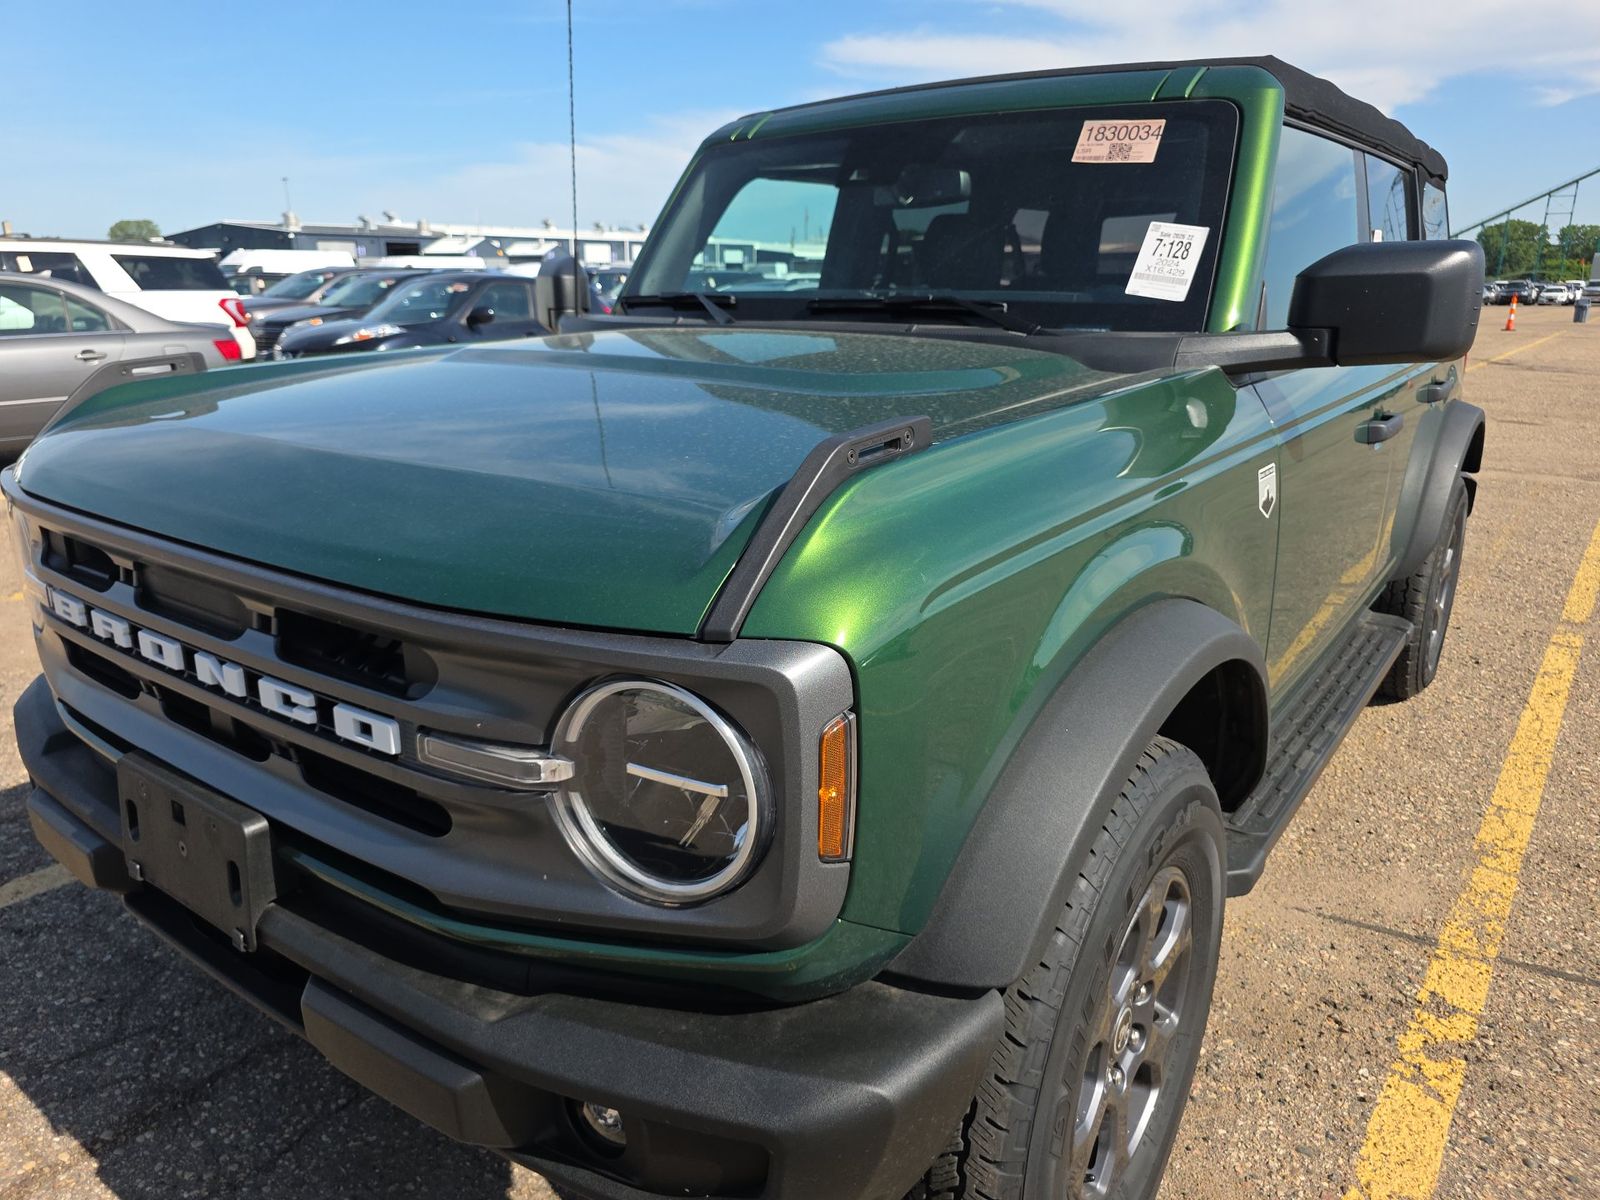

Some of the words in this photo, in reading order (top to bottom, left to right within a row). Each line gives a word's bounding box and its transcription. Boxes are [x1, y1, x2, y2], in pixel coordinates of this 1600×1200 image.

[1086, 124, 1163, 142] 1830034
[1152, 238, 1192, 260] 7:128
[1155, 257, 1180, 267] 2024
[52, 587, 401, 755] BRONCO
